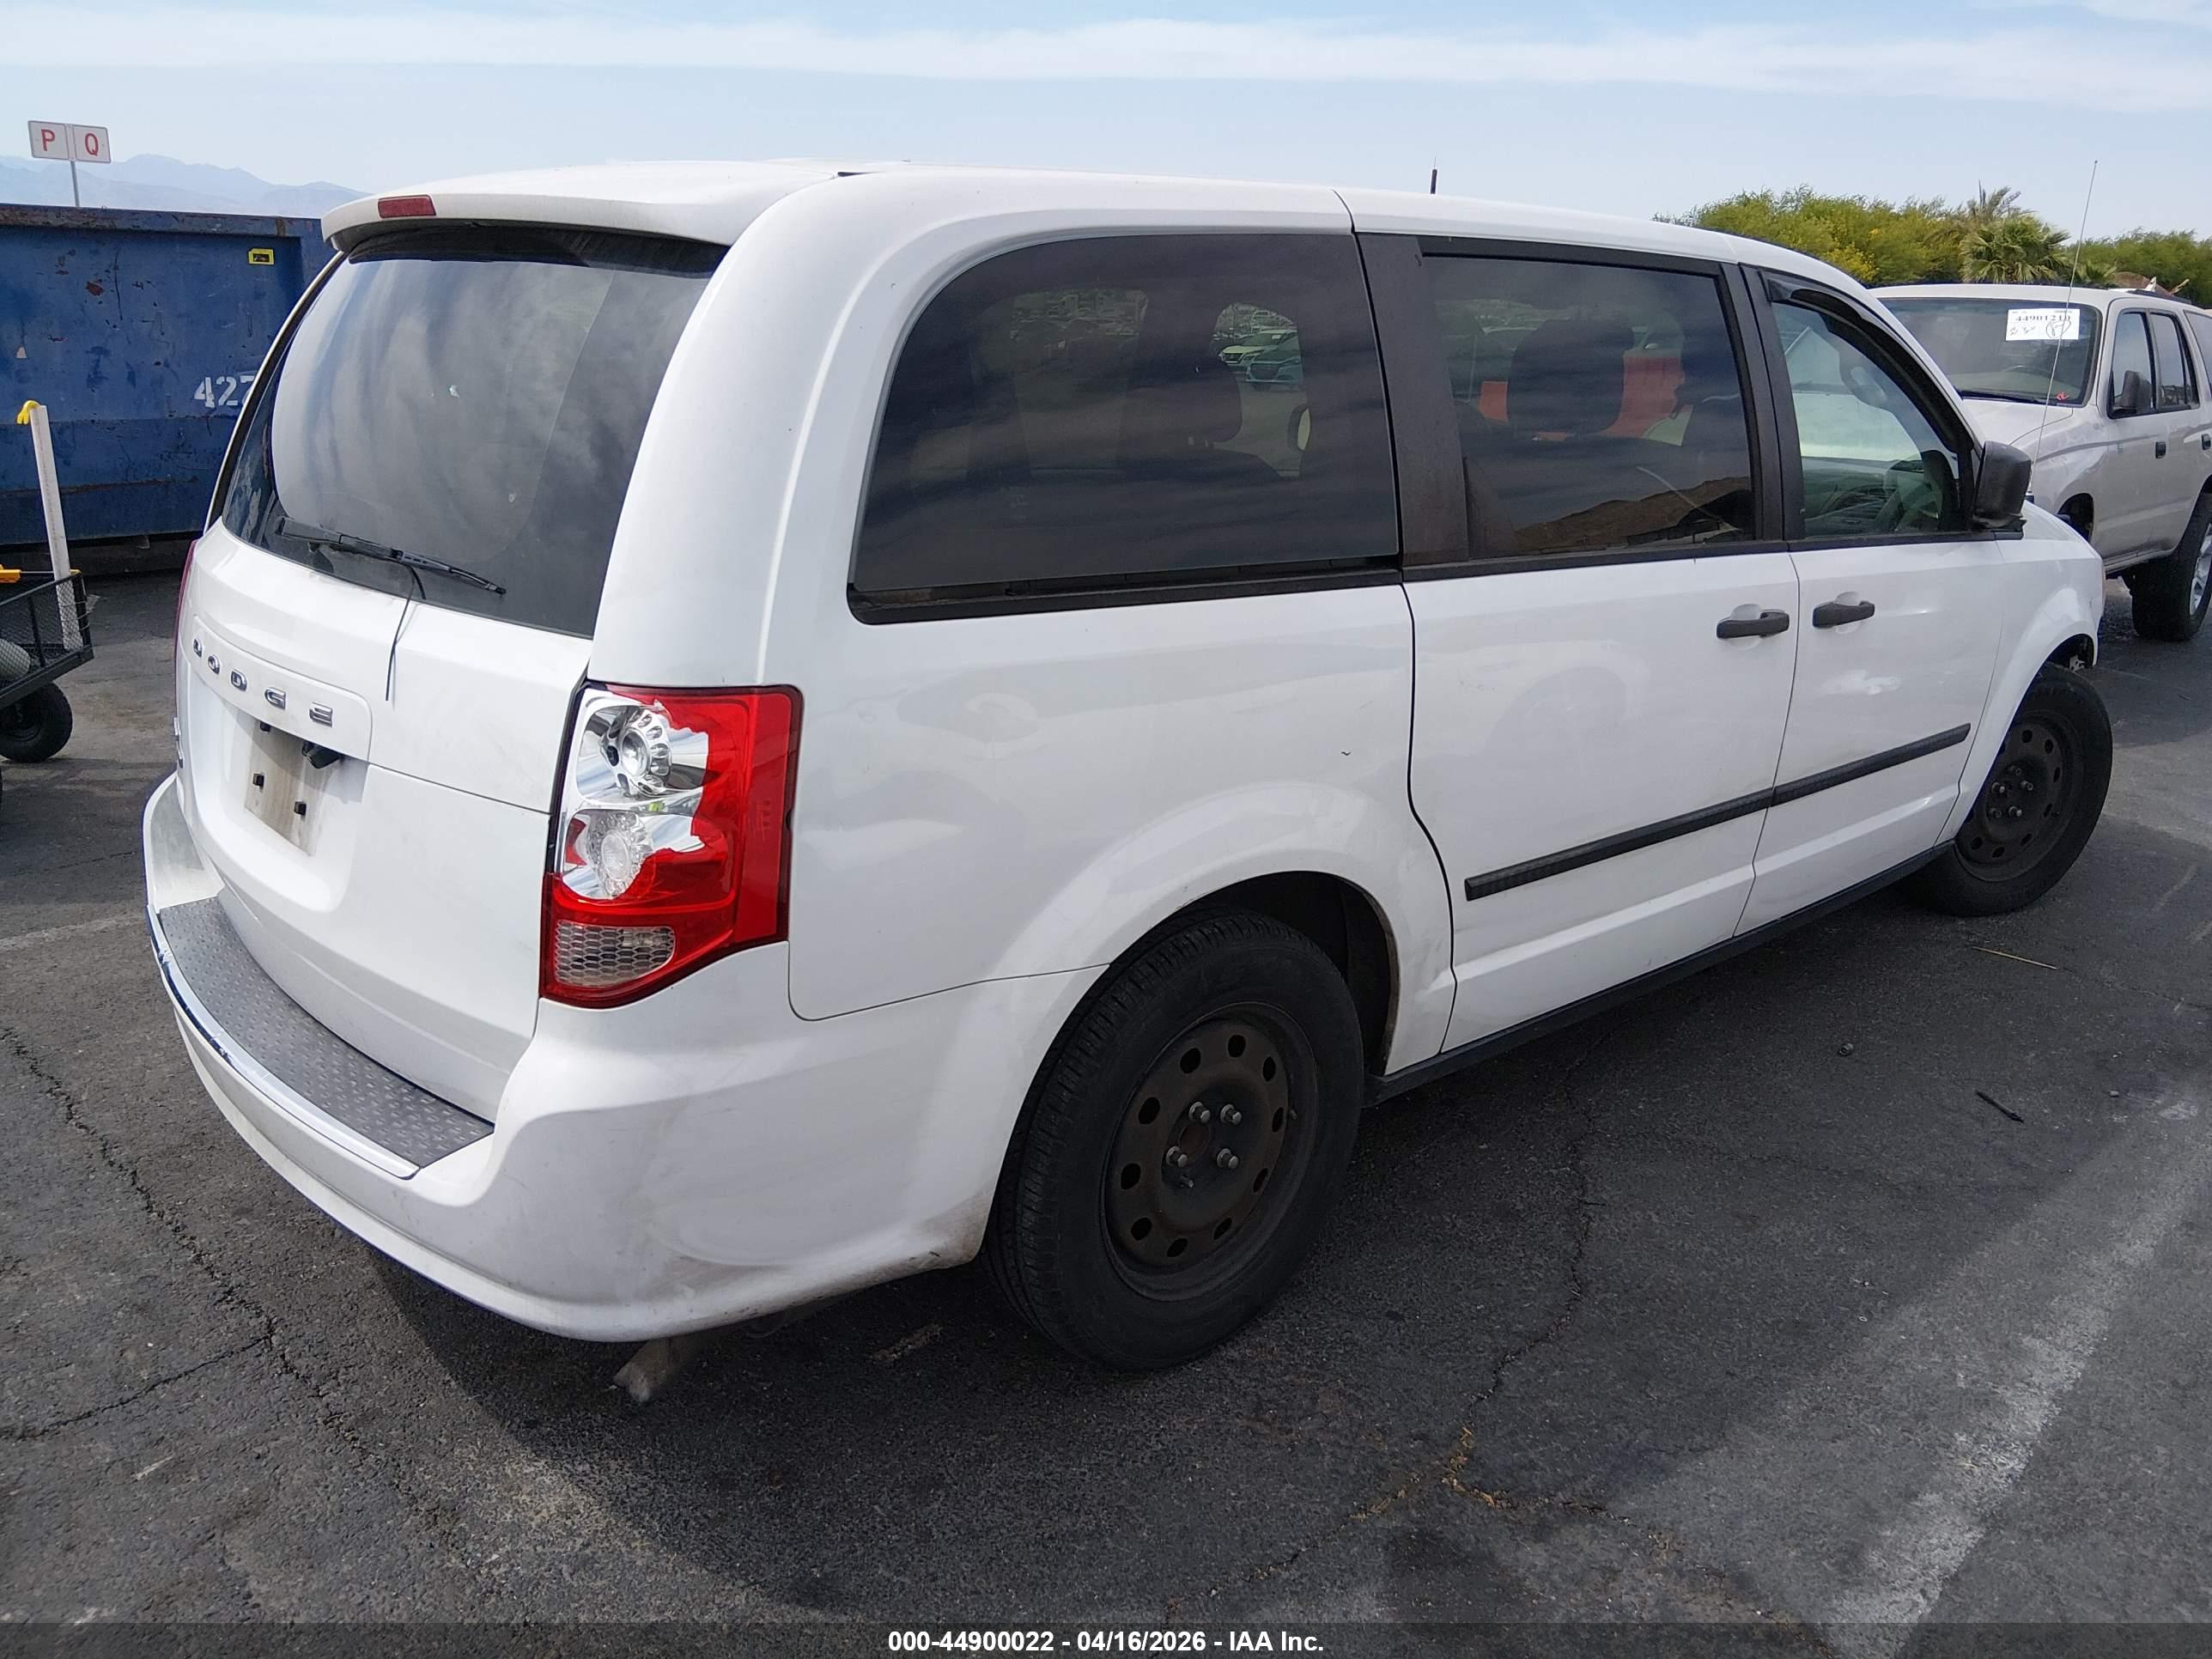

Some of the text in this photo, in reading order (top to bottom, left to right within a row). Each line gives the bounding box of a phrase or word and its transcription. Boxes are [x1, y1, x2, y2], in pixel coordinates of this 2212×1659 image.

[40, 129, 56, 152] P
[84, 132, 99, 156] Q
[193, 639, 333, 728] DODGE
